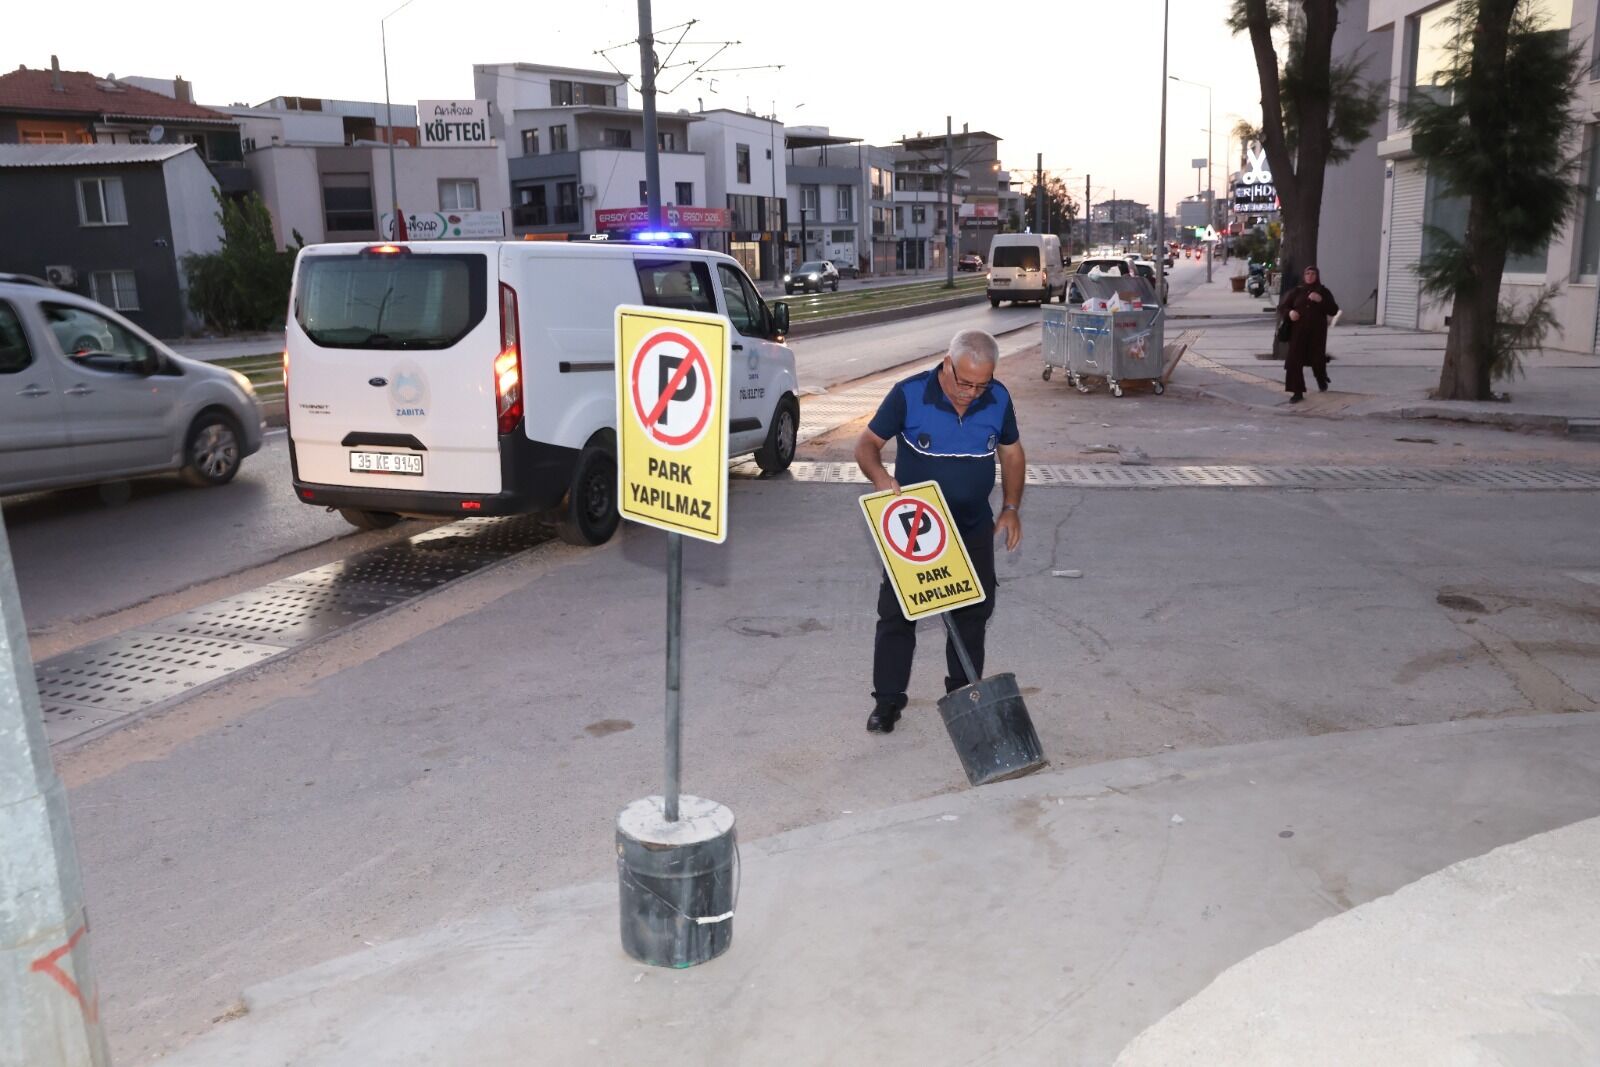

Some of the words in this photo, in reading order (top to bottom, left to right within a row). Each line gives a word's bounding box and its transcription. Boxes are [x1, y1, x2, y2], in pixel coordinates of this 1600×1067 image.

[425, 119, 486, 142] KÖFTECİ
[657, 354, 697, 426] P
[396, 408, 425, 417] ZABITA
[358, 454, 372, 469] 35
[376, 455, 390, 470] KE
[394, 456, 421, 472] 9149
[648, 457, 692, 485] PARK
[630, 482, 711, 520] YAPILMAZ
[898, 510, 932, 552] P
[916, 566, 952, 585] PARK
[909, 580, 972, 606] YAPILMAZ
